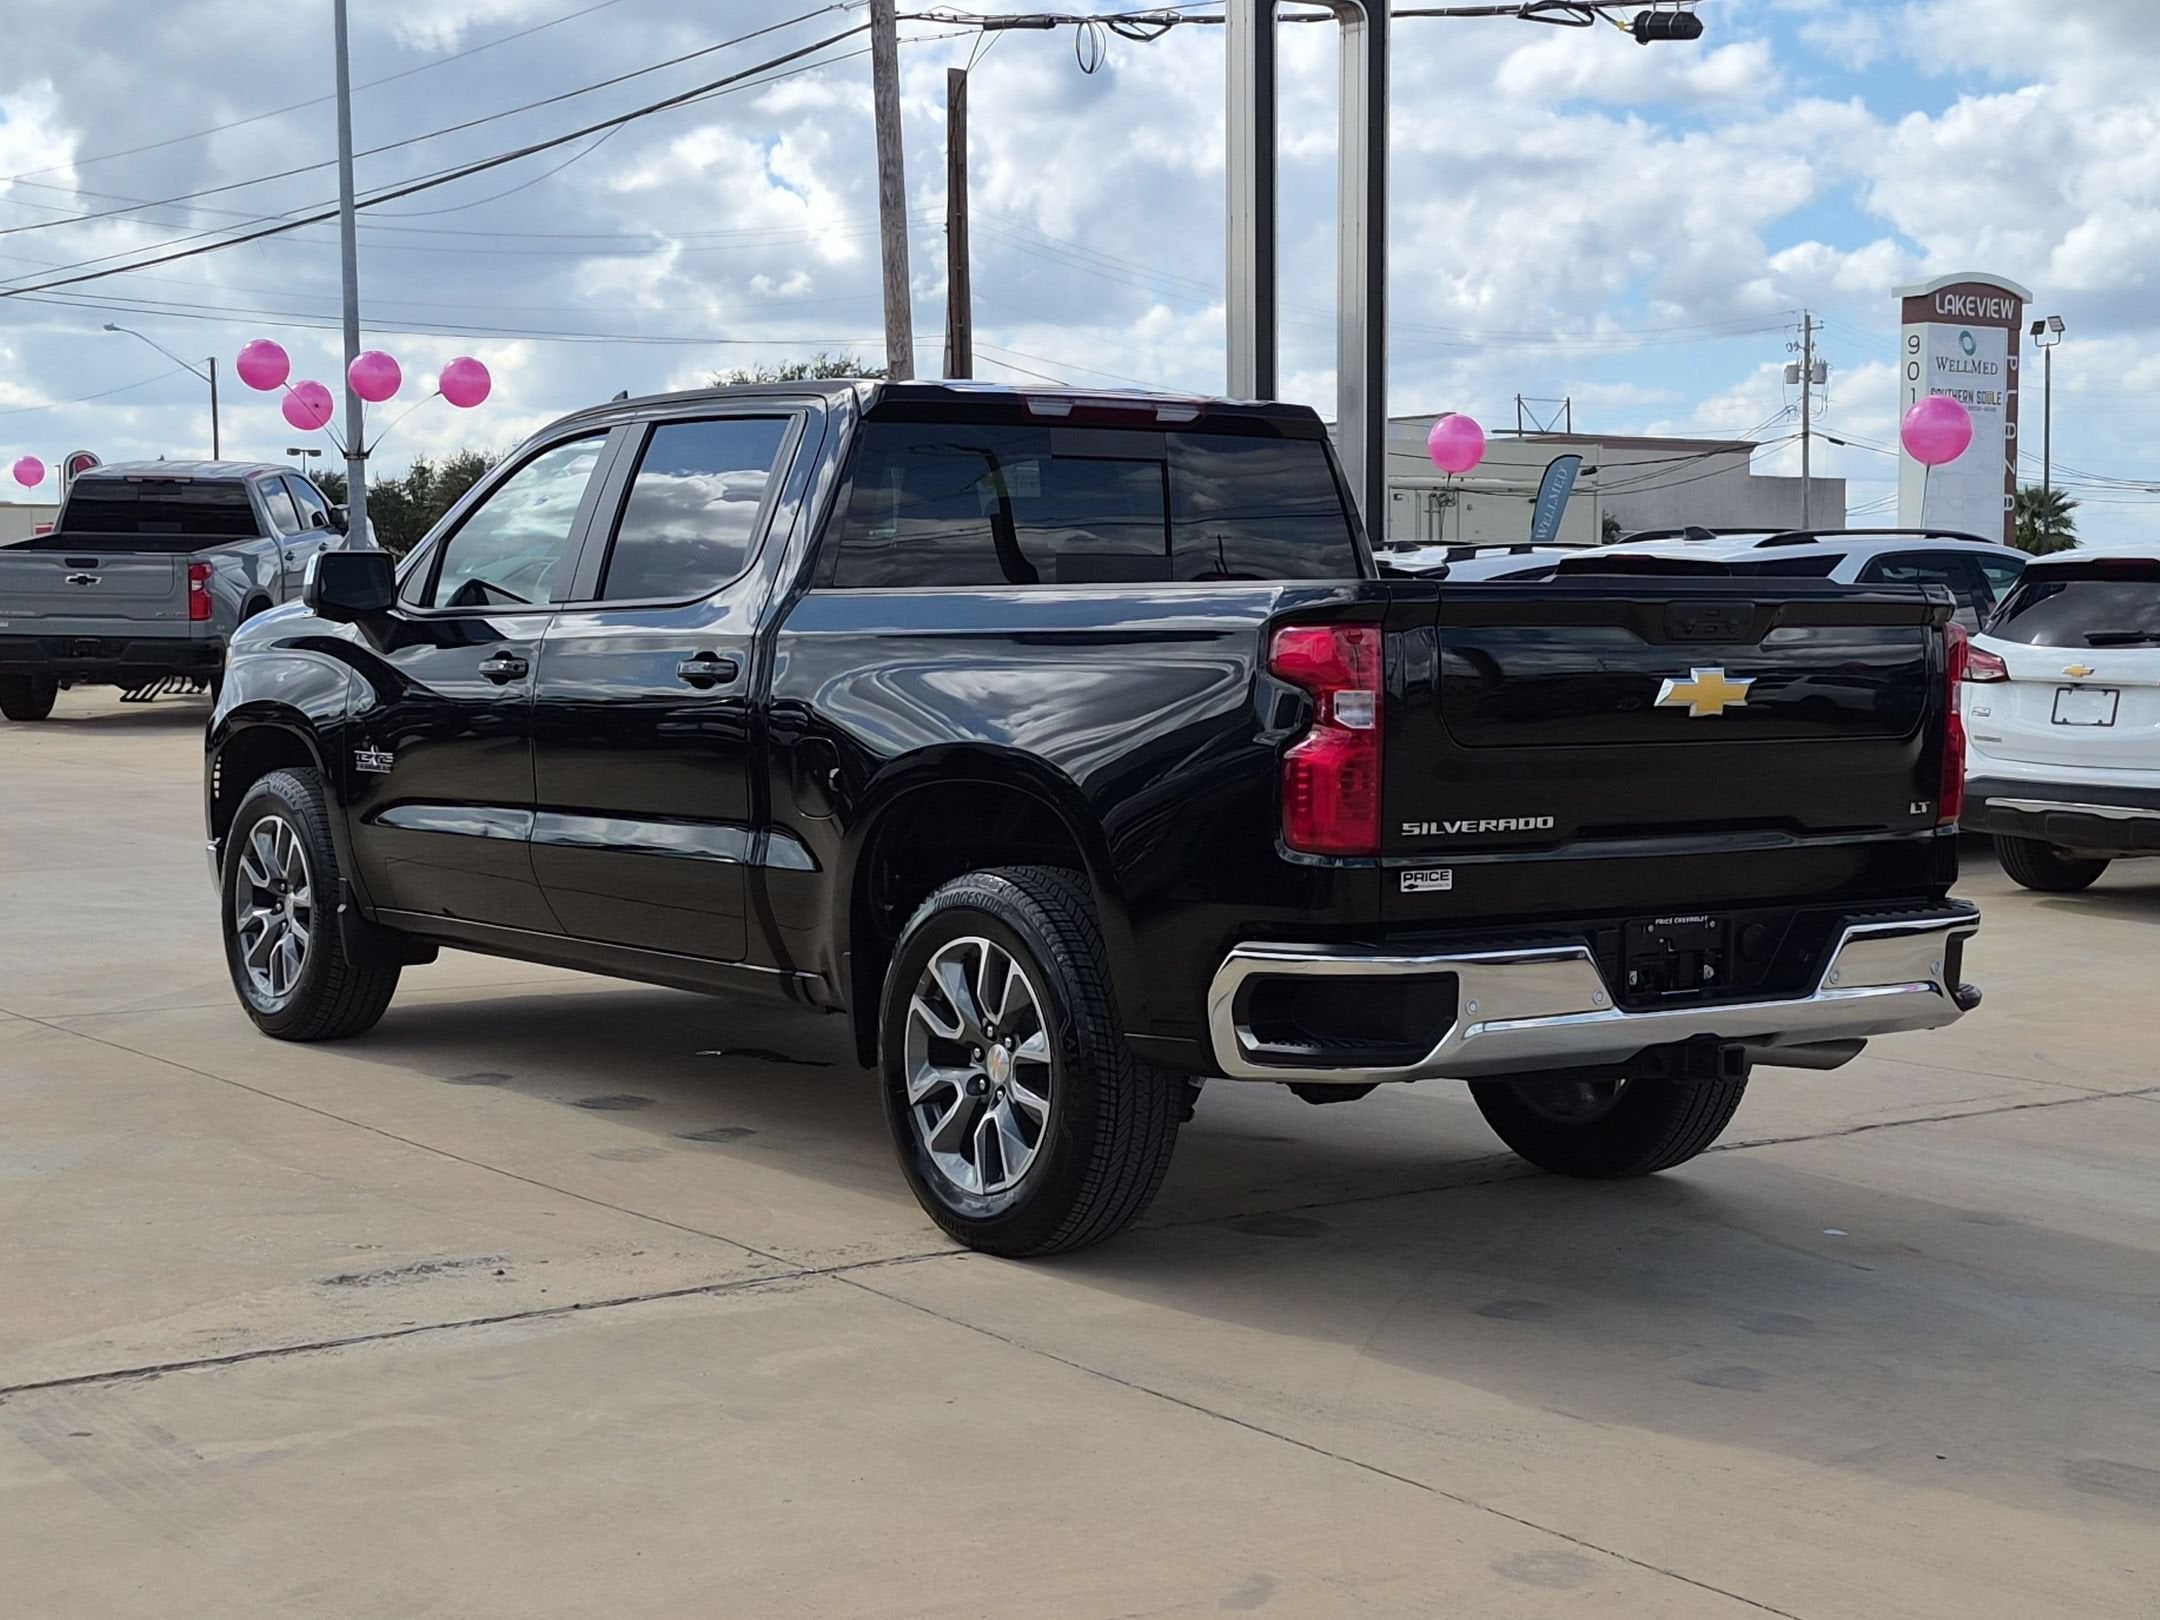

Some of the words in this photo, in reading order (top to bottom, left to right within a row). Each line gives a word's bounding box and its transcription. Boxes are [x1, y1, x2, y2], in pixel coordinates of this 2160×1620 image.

[1935, 293, 2015, 319] LAKEVIEW
[1935, 356, 1999, 375] WELLMED
[1909, 801, 1931, 814] LT
[1401, 816, 1554, 836] SILVERADO
[1403, 871, 1450, 882] PRICE
